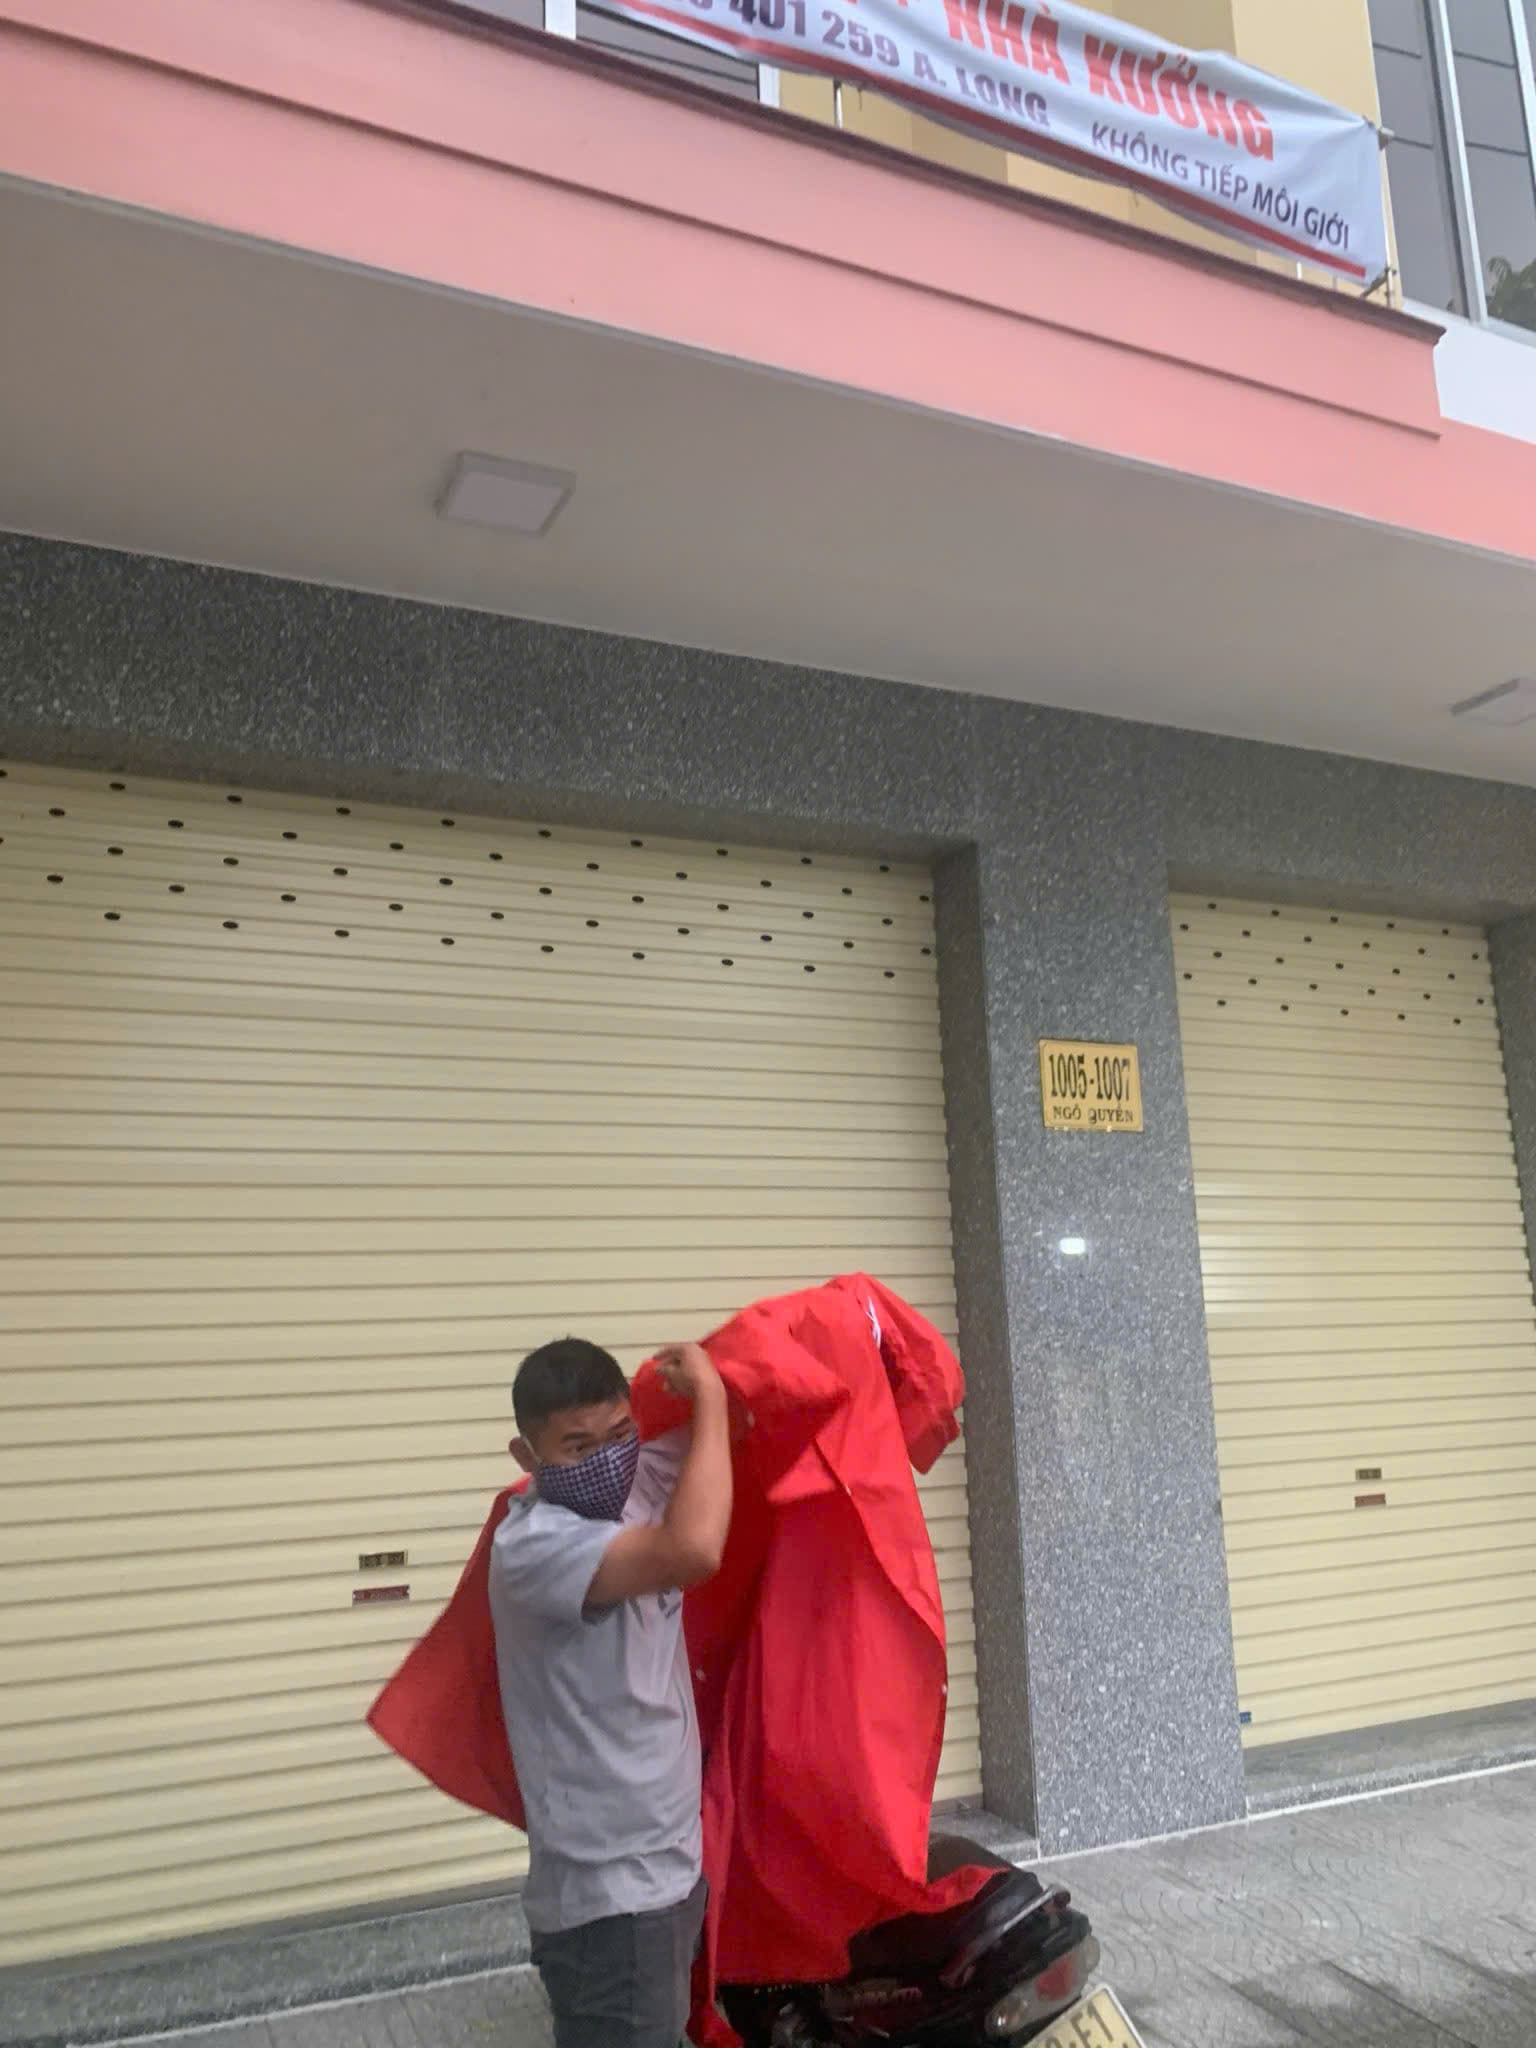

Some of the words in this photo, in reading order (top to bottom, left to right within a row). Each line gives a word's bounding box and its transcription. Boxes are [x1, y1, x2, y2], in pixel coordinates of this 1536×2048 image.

[729, 0, 805, 37] 401
[822, 9, 900, 68] 259
[955, 63, 1050, 127] LONG
[943, 0, 1070, 86] NHÀ
[1084, 32, 1274, 161] XƯỞNG
[1092, 121, 1189, 180] KHÔNG
[1195, 160, 1249, 201] TIẾP
[1252, 181, 1299, 227] MÔI
[1303, 206, 1350, 250] GIỚI
